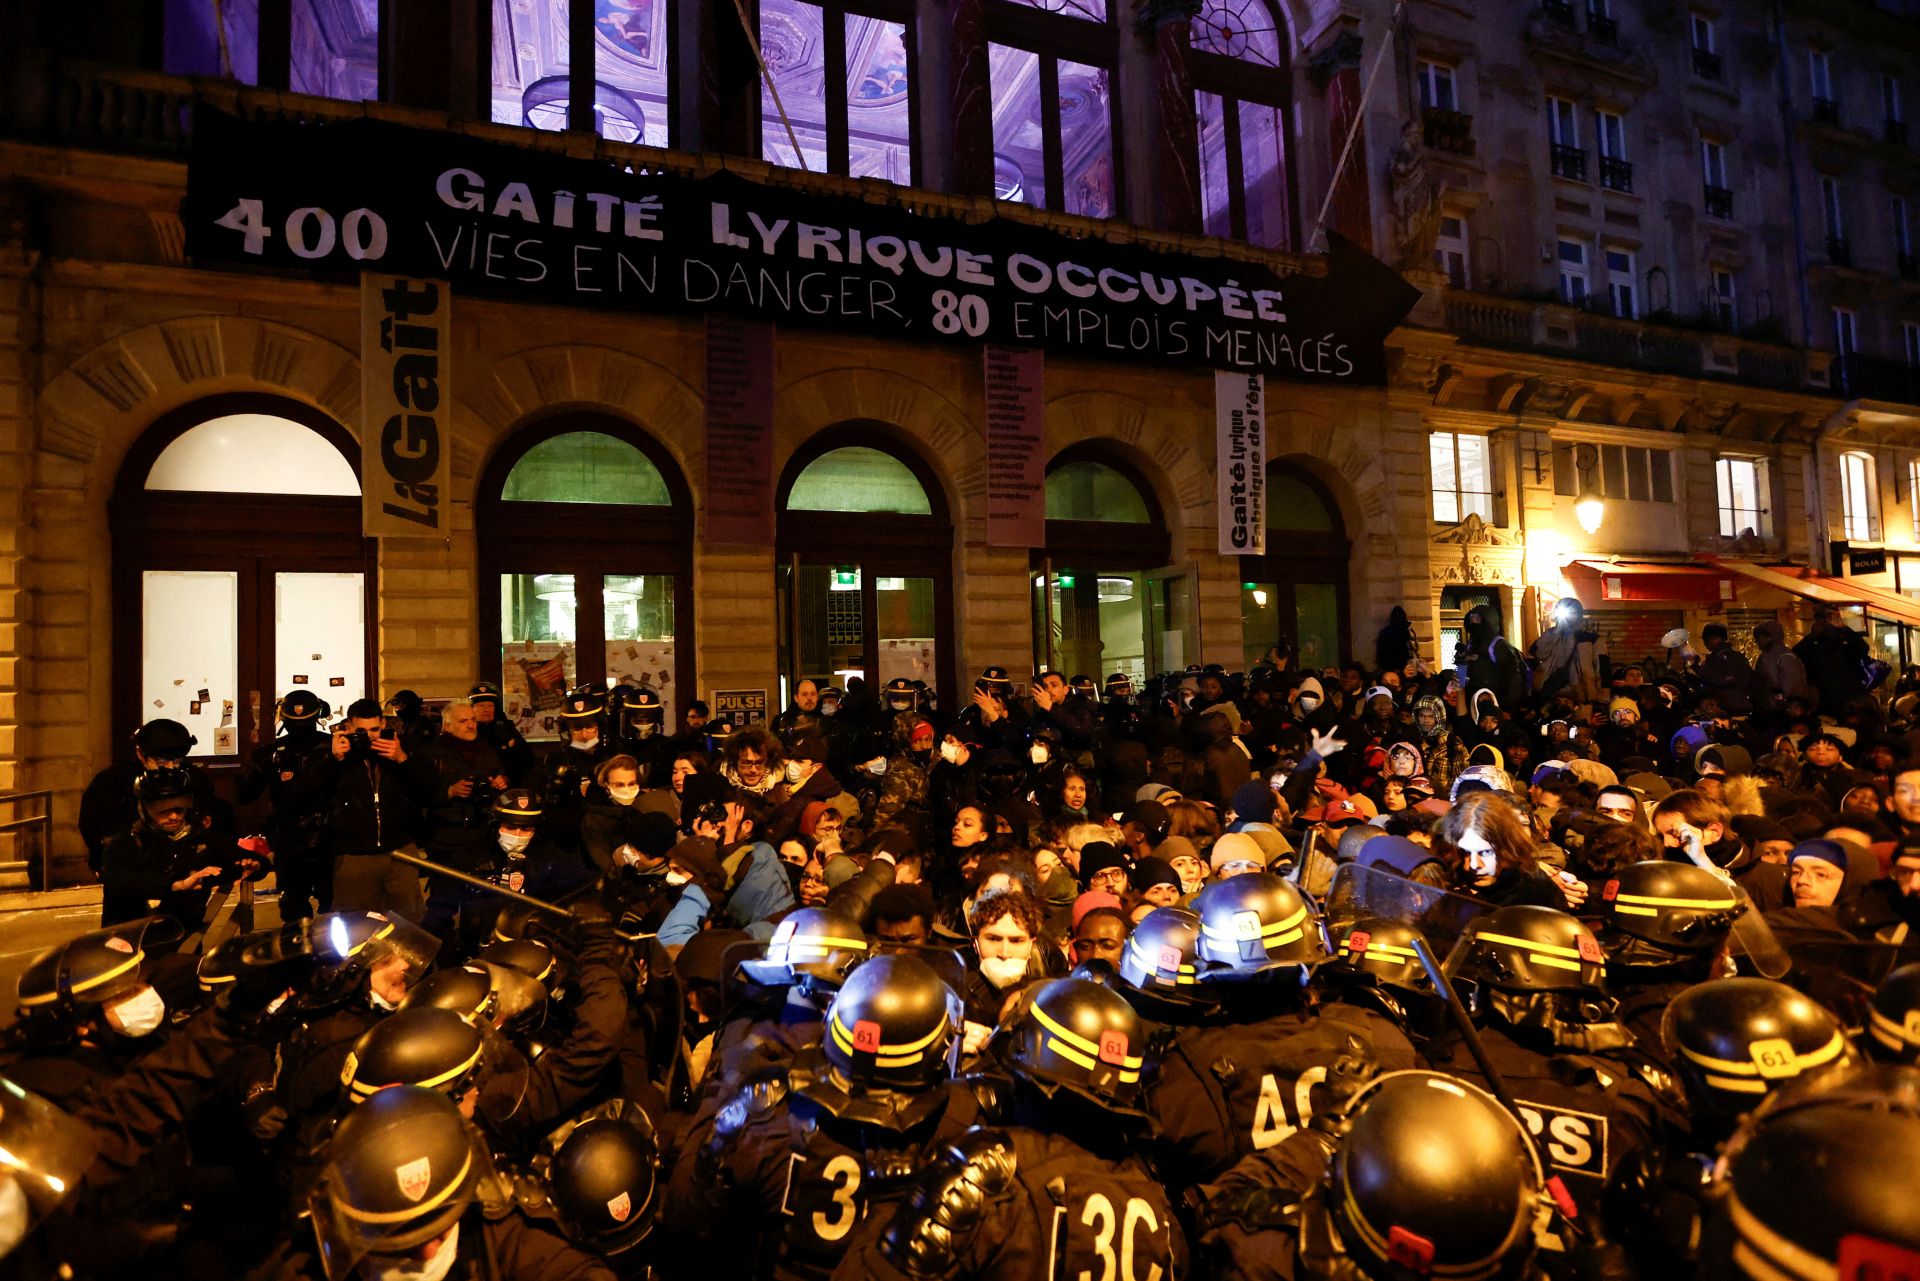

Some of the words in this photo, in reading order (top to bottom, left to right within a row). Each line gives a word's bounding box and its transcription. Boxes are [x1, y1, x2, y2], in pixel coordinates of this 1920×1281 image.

[435, 167, 664, 241] GAÎTÉ
[712, 201, 995, 287] LYRIQUE
[1007, 252, 1287, 323] OCCUPÉE
[213, 197, 388, 260] 400
[573, 244, 657, 293] EN
[684, 259, 913, 329] DANGER,
[931, 289, 990, 337] 80
[1206, 328, 1354, 376] MENACÉS
[1229, 409, 1247, 460] Lyrique
[1248, 419, 1260, 447] de
[1230, 462, 1248, 548] Gaîté
[1250, 450, 1263, 548] Fabrique
[717, 696, 764, 709] PULSE
[1353, 936, 1365, 947] 61
[1583, 942, 1598, 955] 61
[1161, 952, 1176, 964] 61
[857, 1032, 874, 1045] 61
[1105, 1040, 1123, 1055] 61
[1761, 1050, 1789, 1067] 61
[1079, 1192, 1163, 1281] 3C
